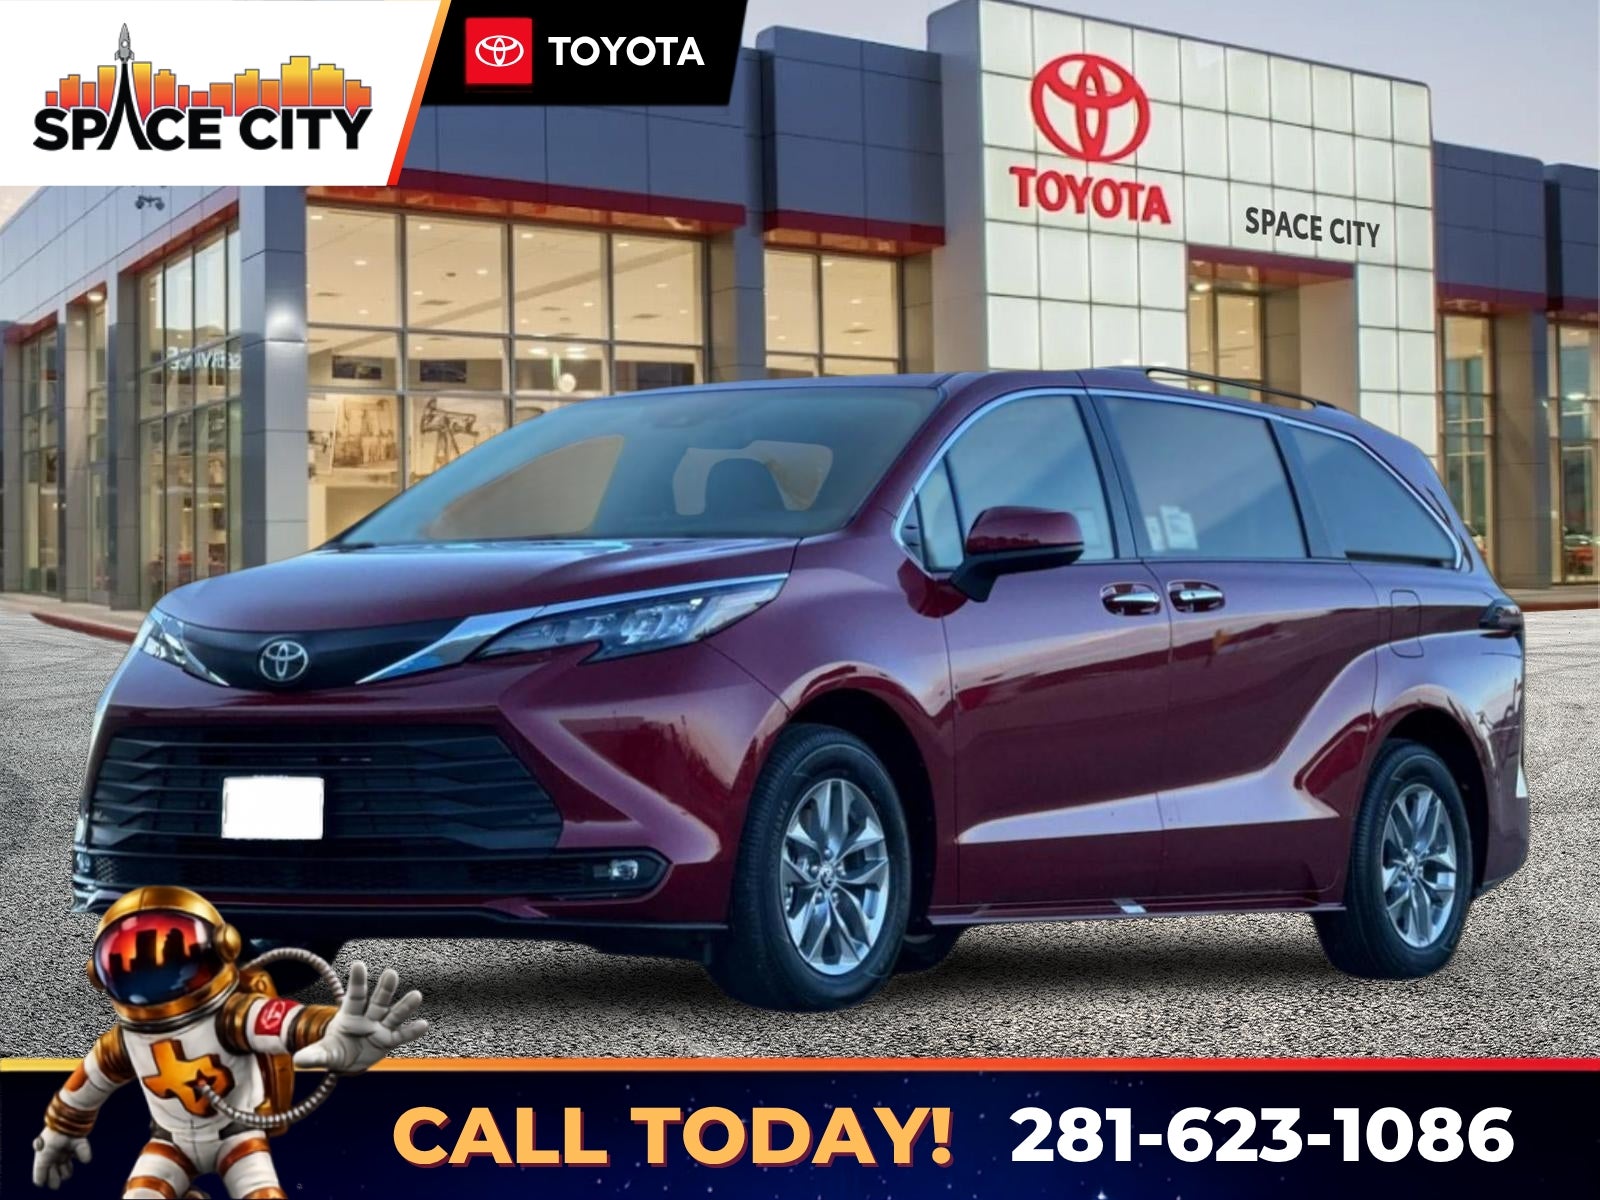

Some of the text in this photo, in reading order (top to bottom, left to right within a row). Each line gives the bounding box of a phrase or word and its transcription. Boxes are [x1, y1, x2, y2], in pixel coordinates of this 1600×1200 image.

[1009, 166, 1171, 224] TOYOTA
[1245, 207, 1380, 248] SPACE CITY
